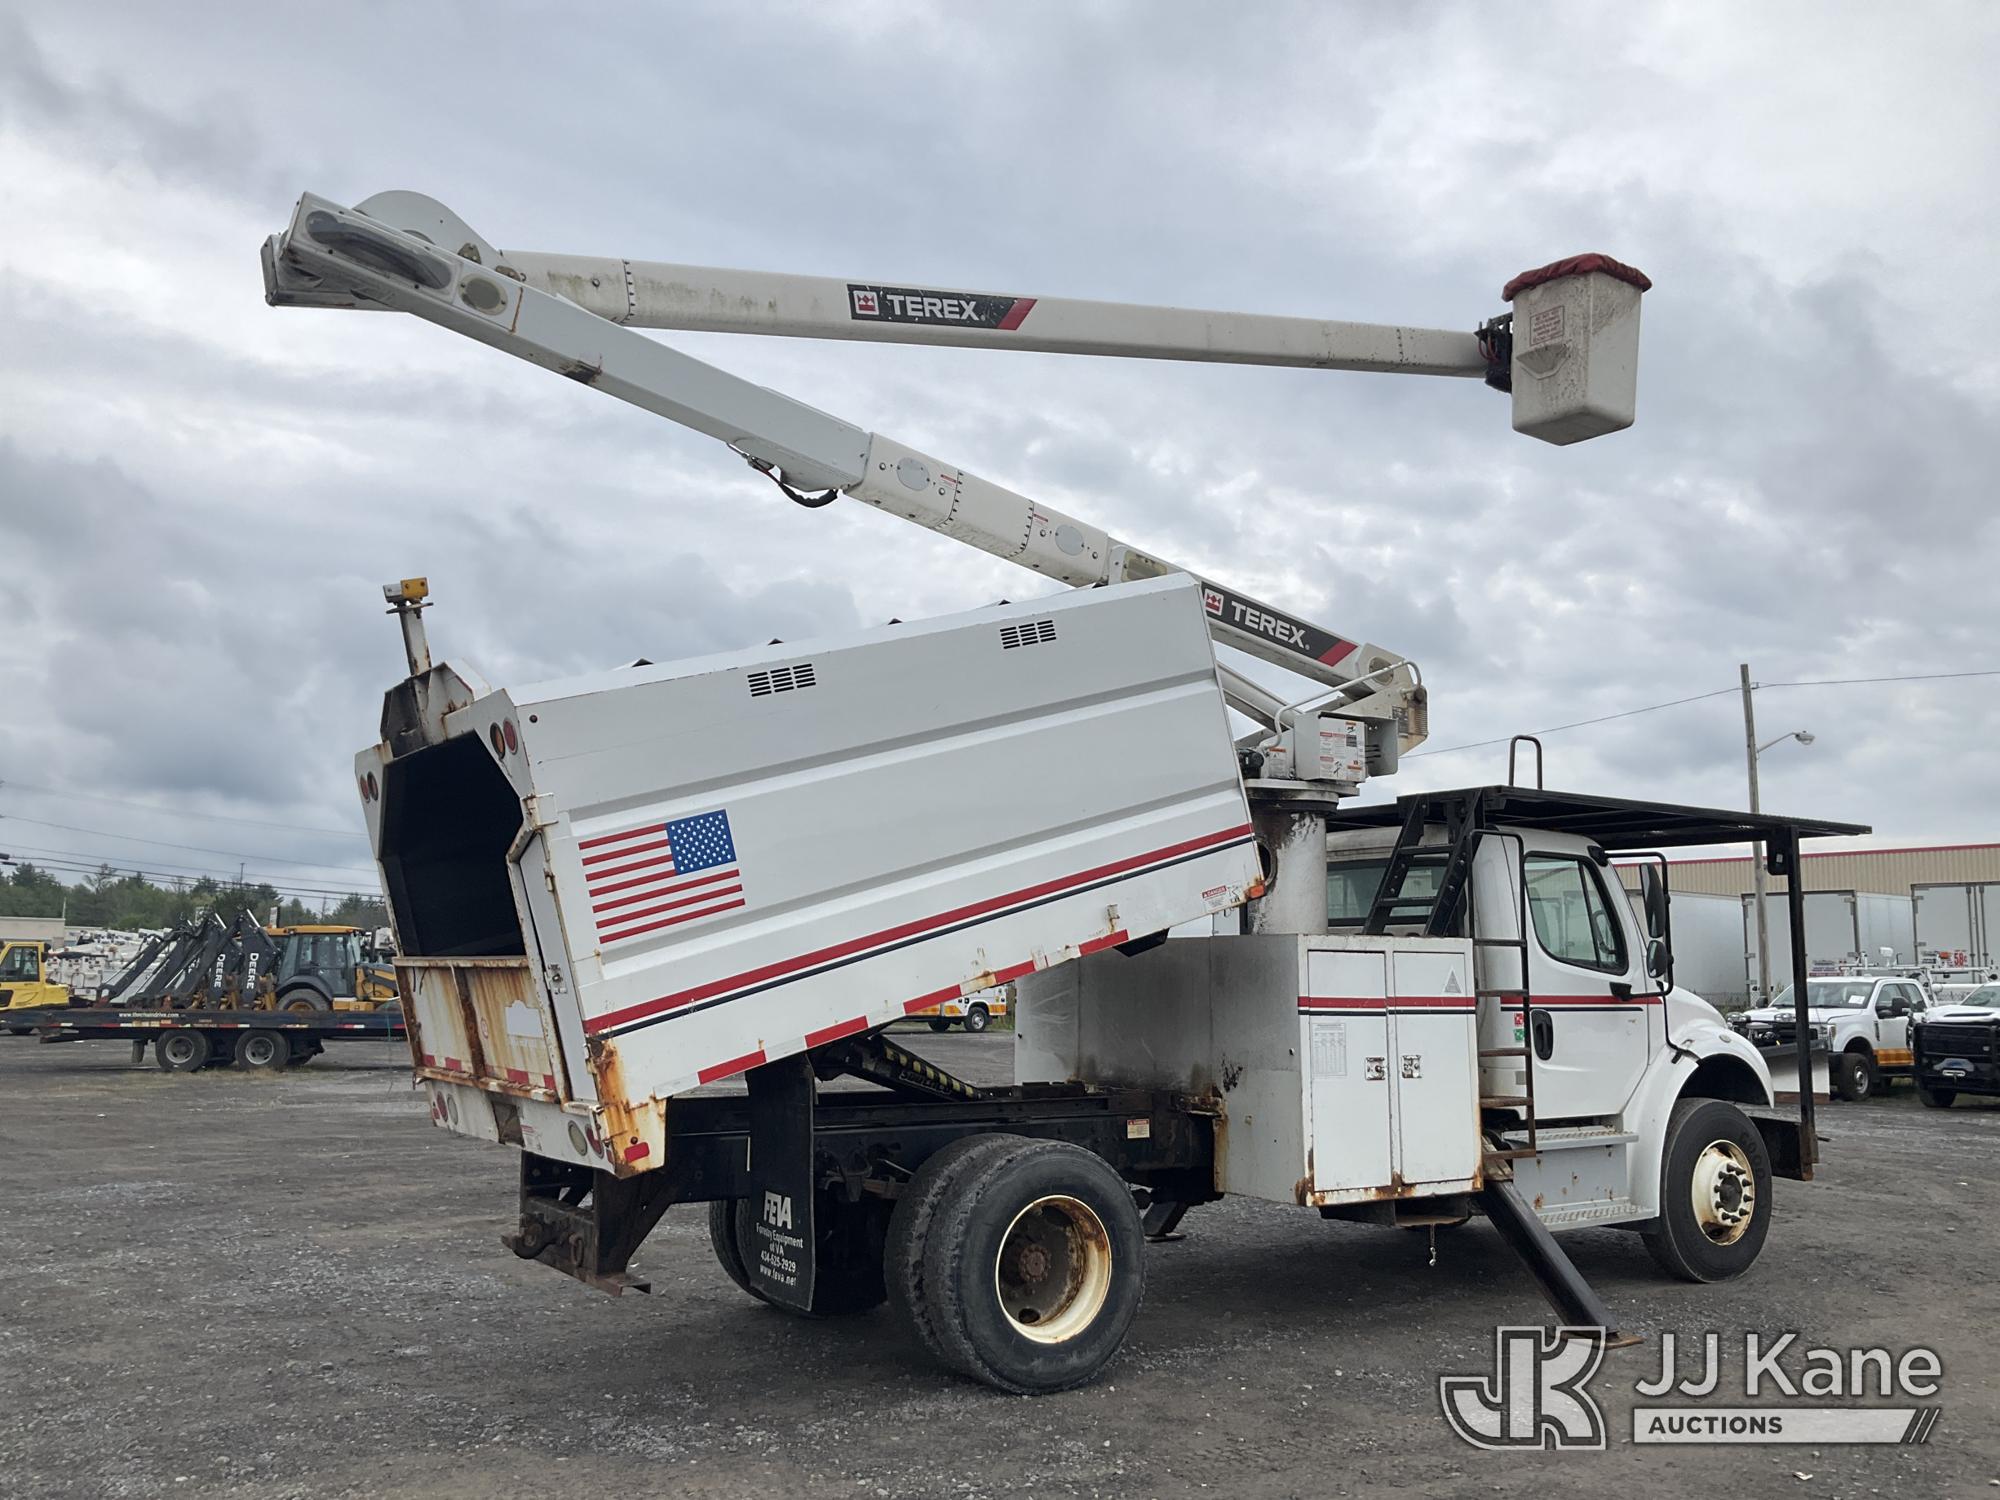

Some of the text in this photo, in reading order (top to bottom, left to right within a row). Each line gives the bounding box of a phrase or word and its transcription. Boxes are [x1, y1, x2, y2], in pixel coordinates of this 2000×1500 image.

[886, 294, 980, 321] TEREX
[1231, 601, 1306, 649] TEREX
[214, 953, 226, 988] DEERE
[246, 952, 259, 989] DEERE
